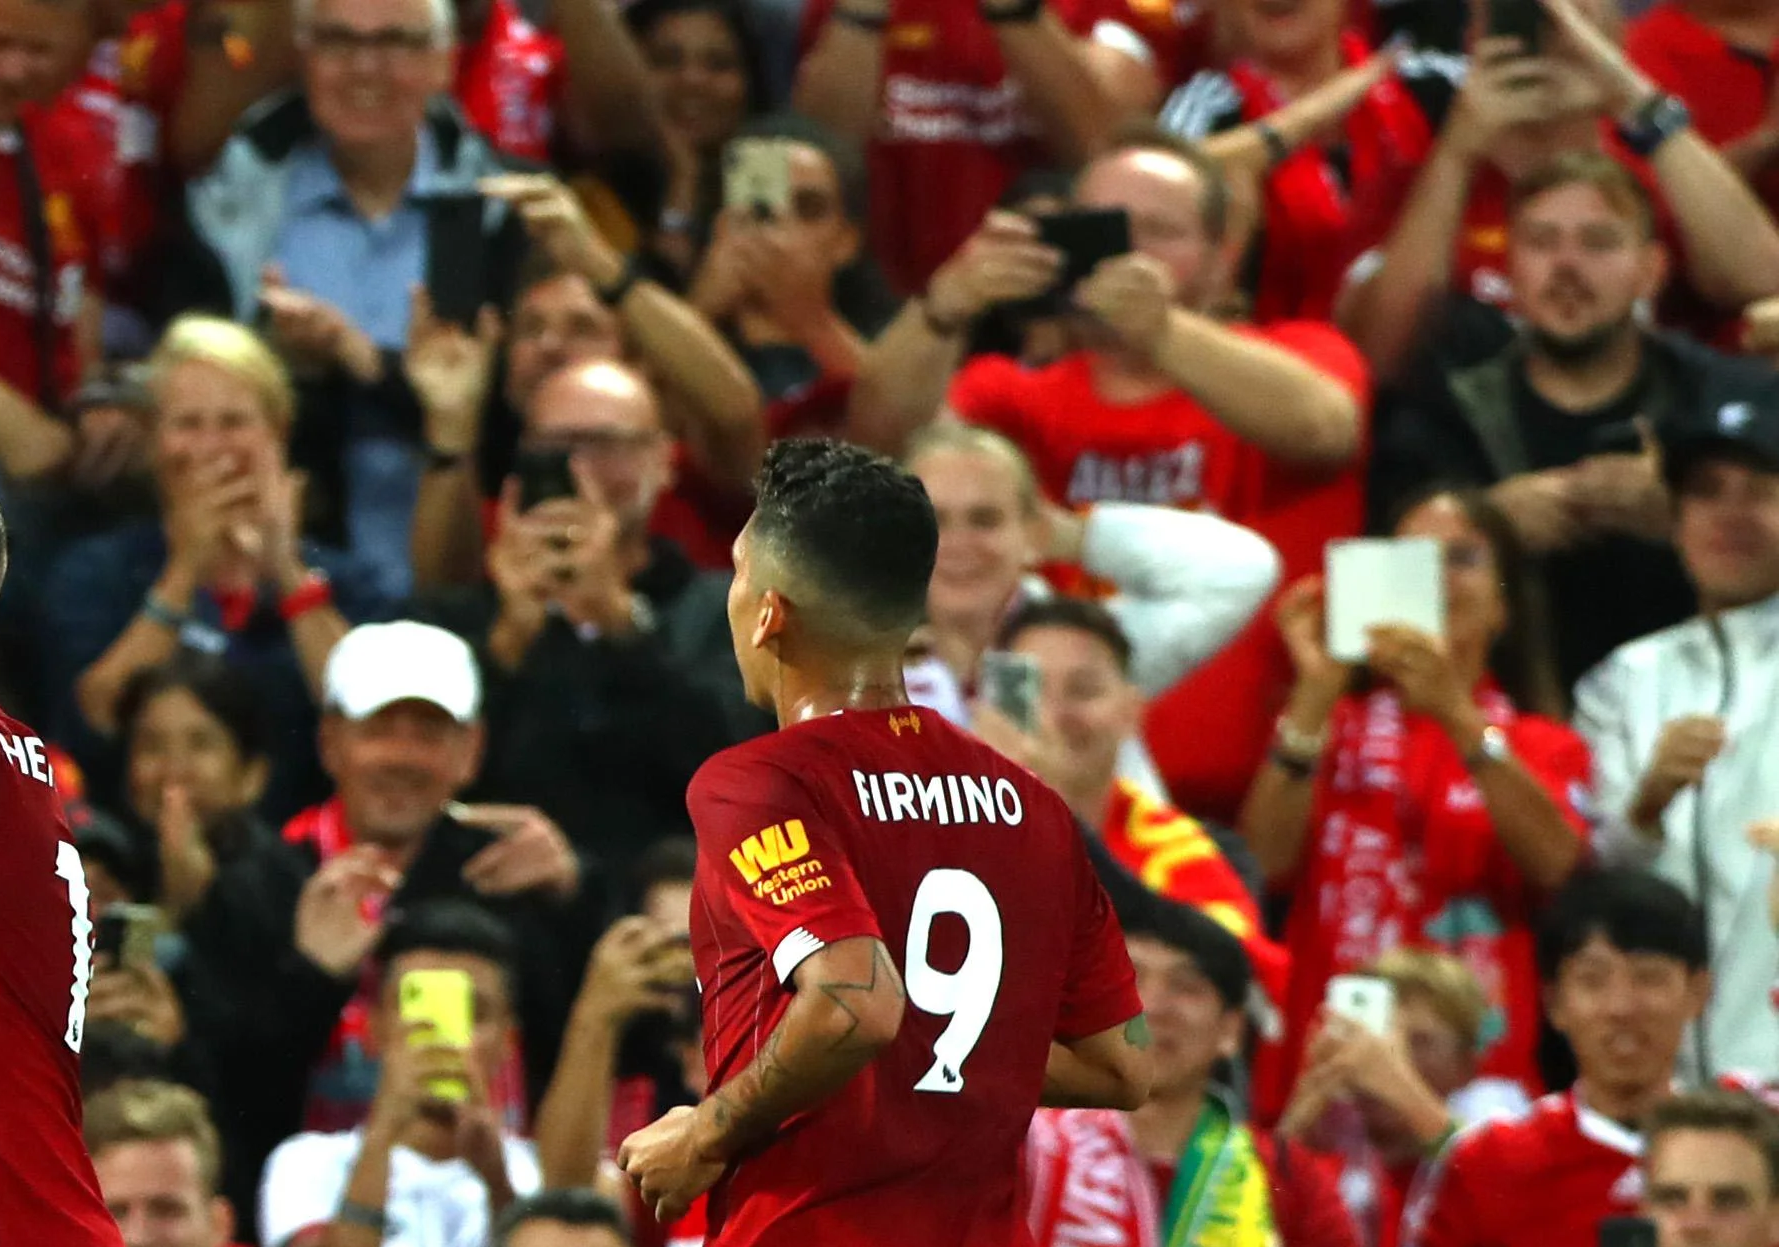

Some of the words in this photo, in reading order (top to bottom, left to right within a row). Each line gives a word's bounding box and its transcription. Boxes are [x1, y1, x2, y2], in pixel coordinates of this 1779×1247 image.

[852, 768, 1023, 826] FIRMINO
[728, 818, 811, 885] WU
[770, 875, 833, 906] Union
[905, 867, 1004, 1093] 9
